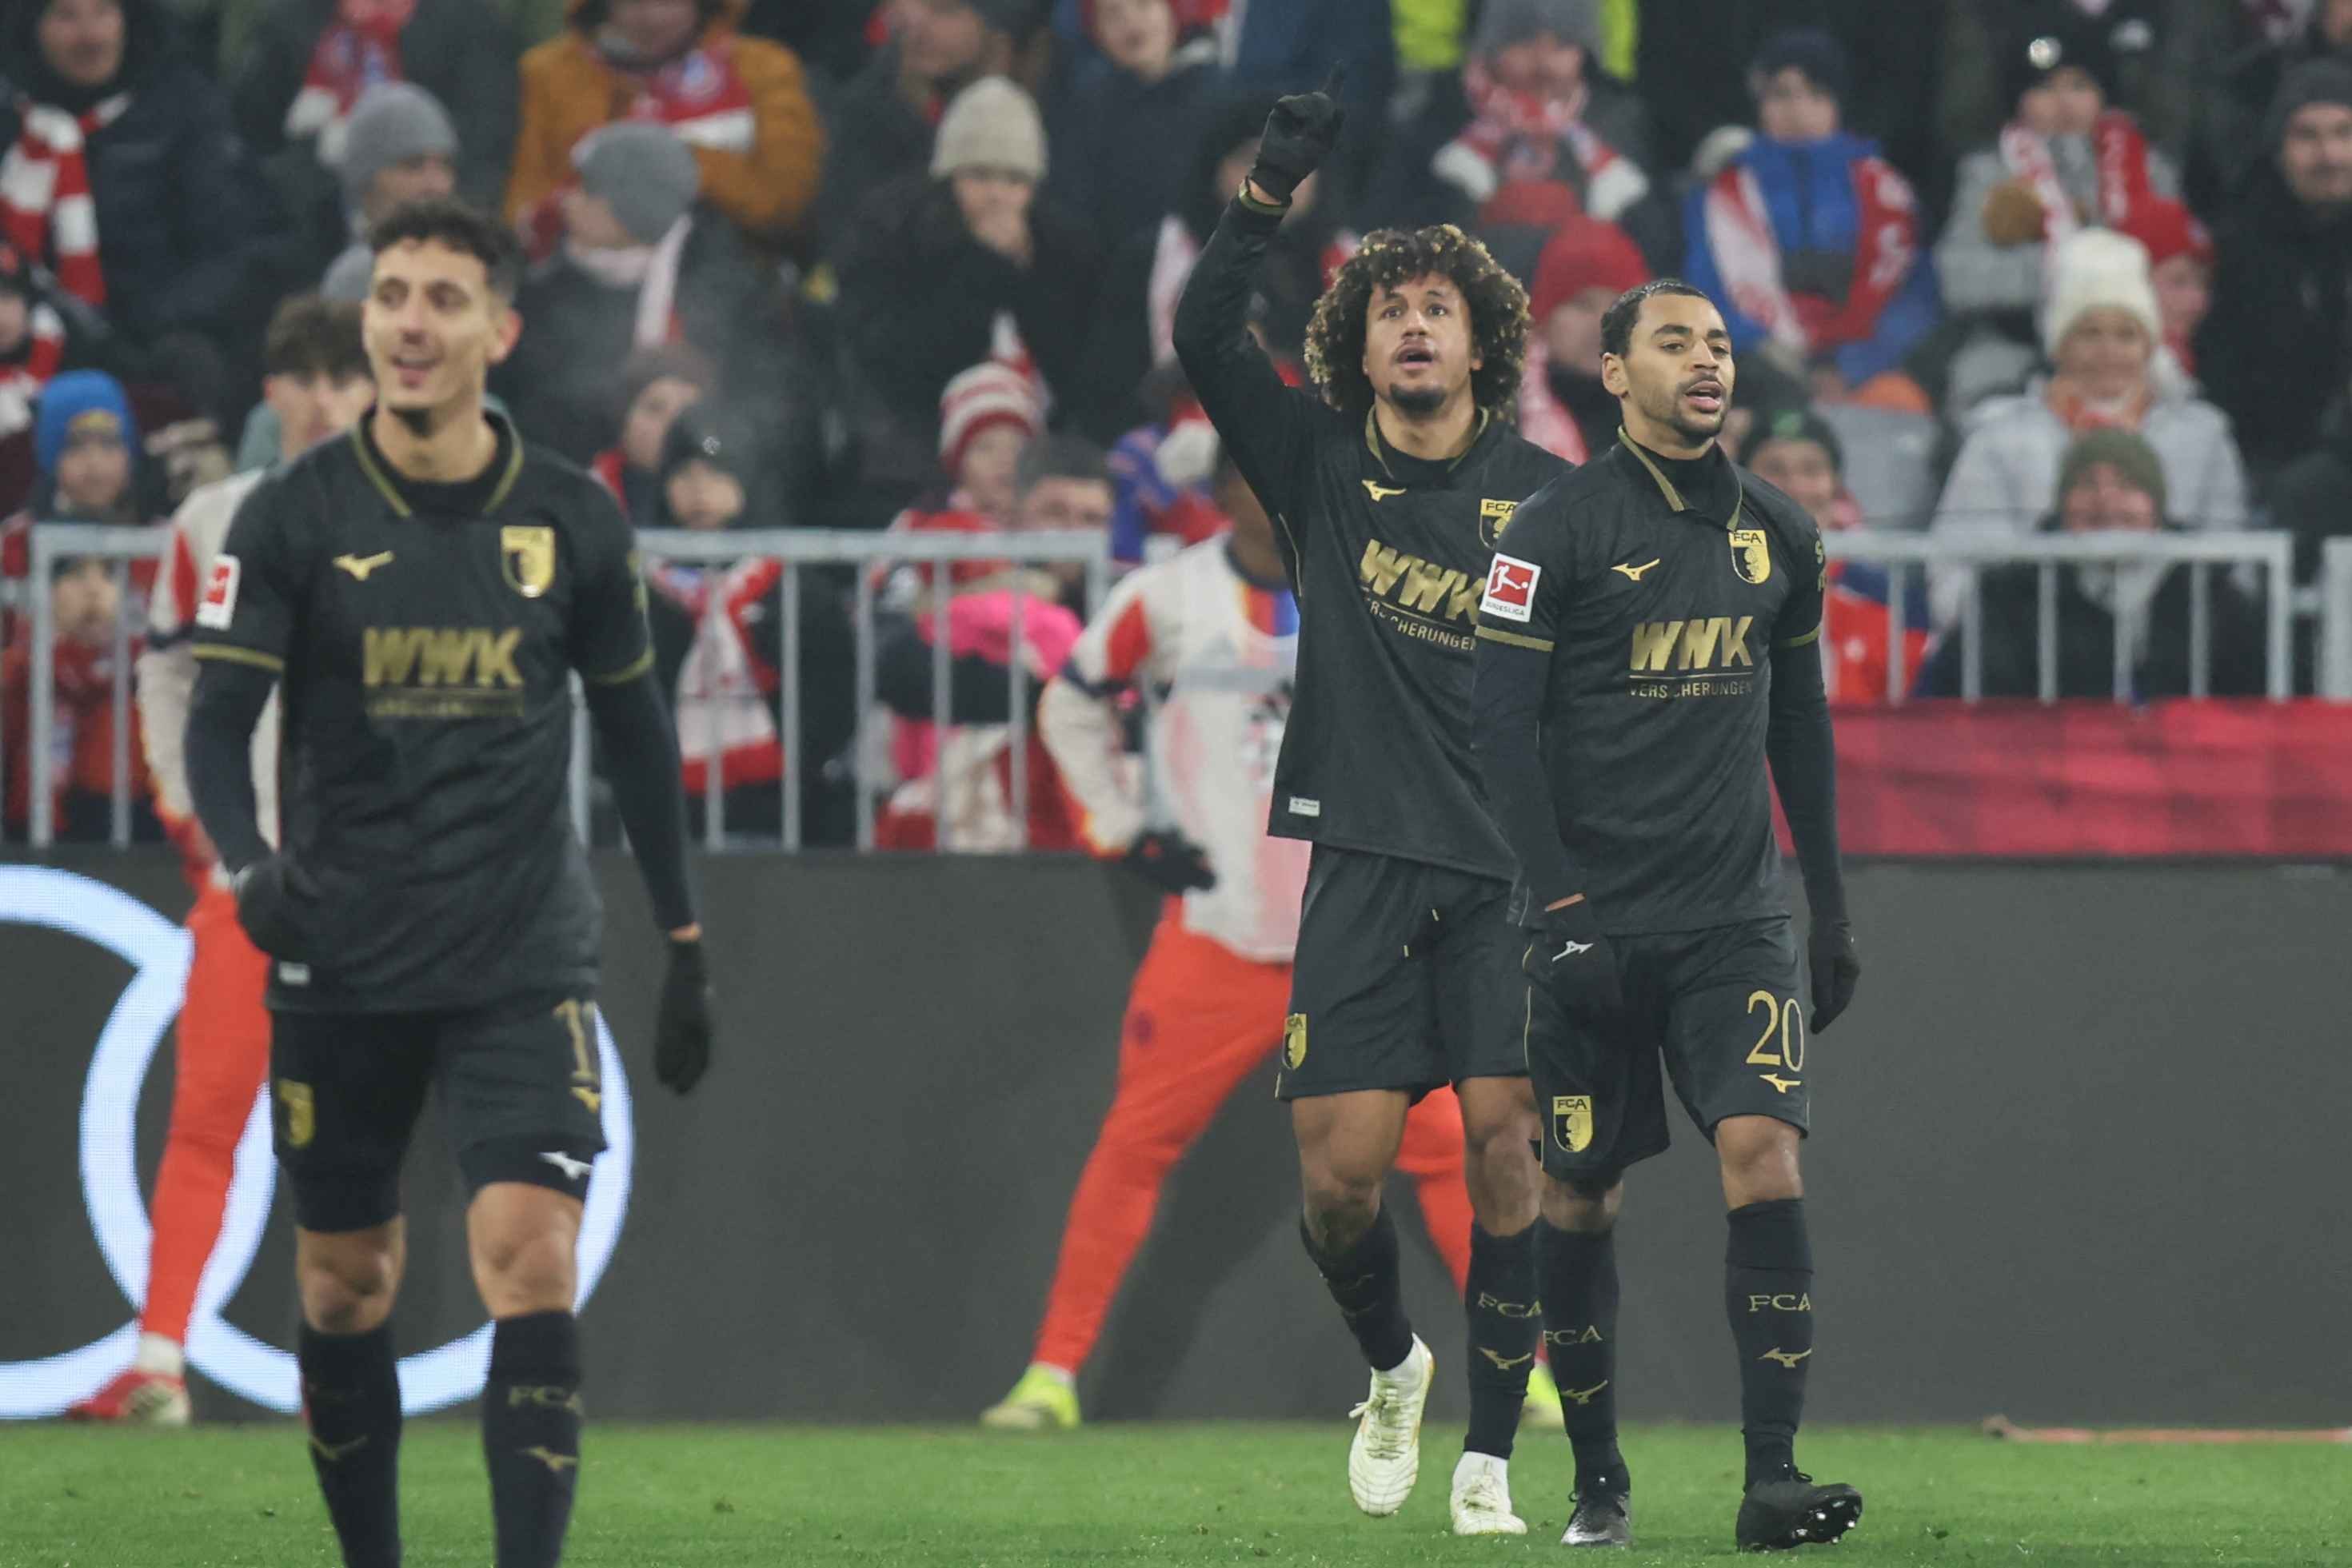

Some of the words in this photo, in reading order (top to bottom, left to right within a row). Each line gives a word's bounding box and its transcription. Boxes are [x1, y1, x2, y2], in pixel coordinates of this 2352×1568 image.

[1485, 502, 1516, 513] FCA
[1734, 532, 1763, 544] FCA
[1360, 538, 1487, 625] WWK
[1630, 615, 1754, 671] WWK
[362, 626, 525, 688] WWK
[1745, 990, 1805, 1072] 20
[1557, 1098, 1587, 1111] FCA
[1477, 1291, 1543, 1319] FCA
[1749, 1292, 1811, 1312] FCA
[1542, 1324, 1603, 1347] FCA
